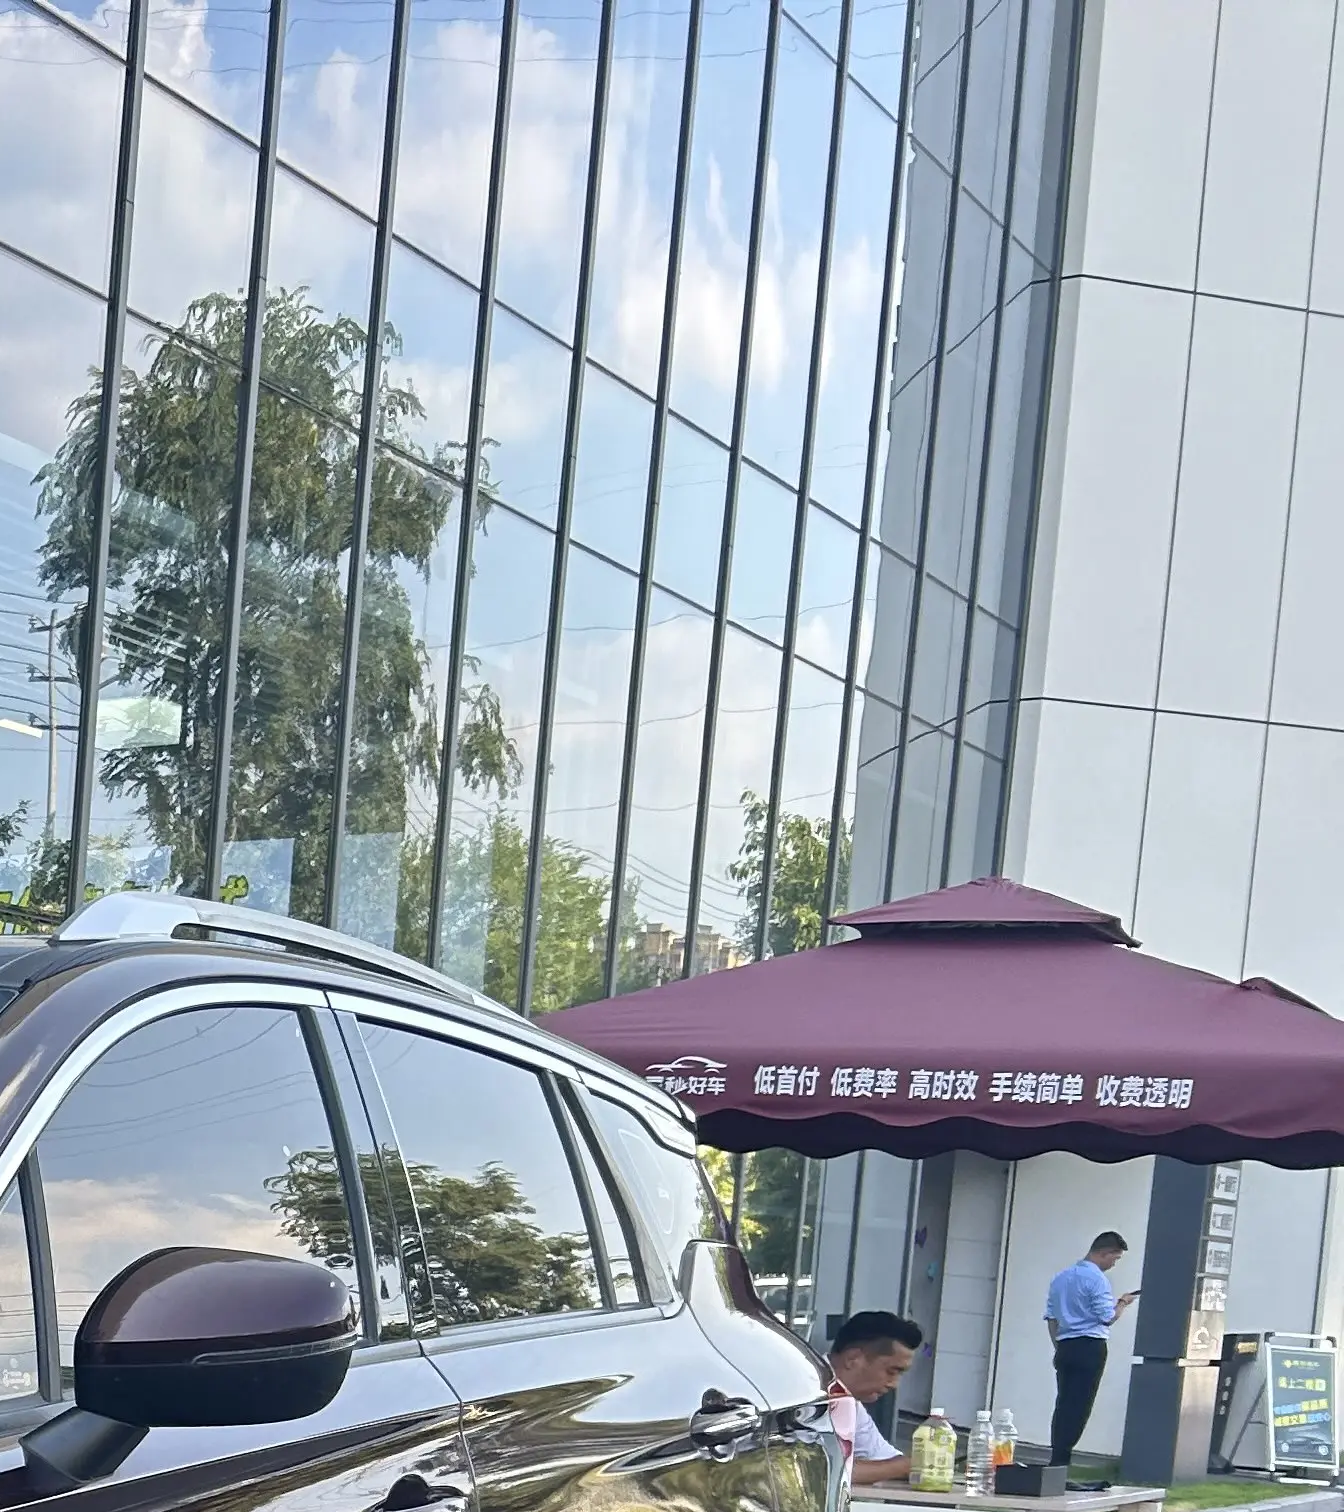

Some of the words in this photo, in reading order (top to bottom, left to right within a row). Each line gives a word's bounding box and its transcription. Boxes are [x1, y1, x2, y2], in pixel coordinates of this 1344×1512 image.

[753, 1065, 821, 1096] 低首付
[830, 1066, 899, 1099] 低费率
[907, 1069, 980, 1101] 高时效
[988, 1072, 1084, 1105] 手续简单
[1095, 1074, 1194, 1109] 收费透明
